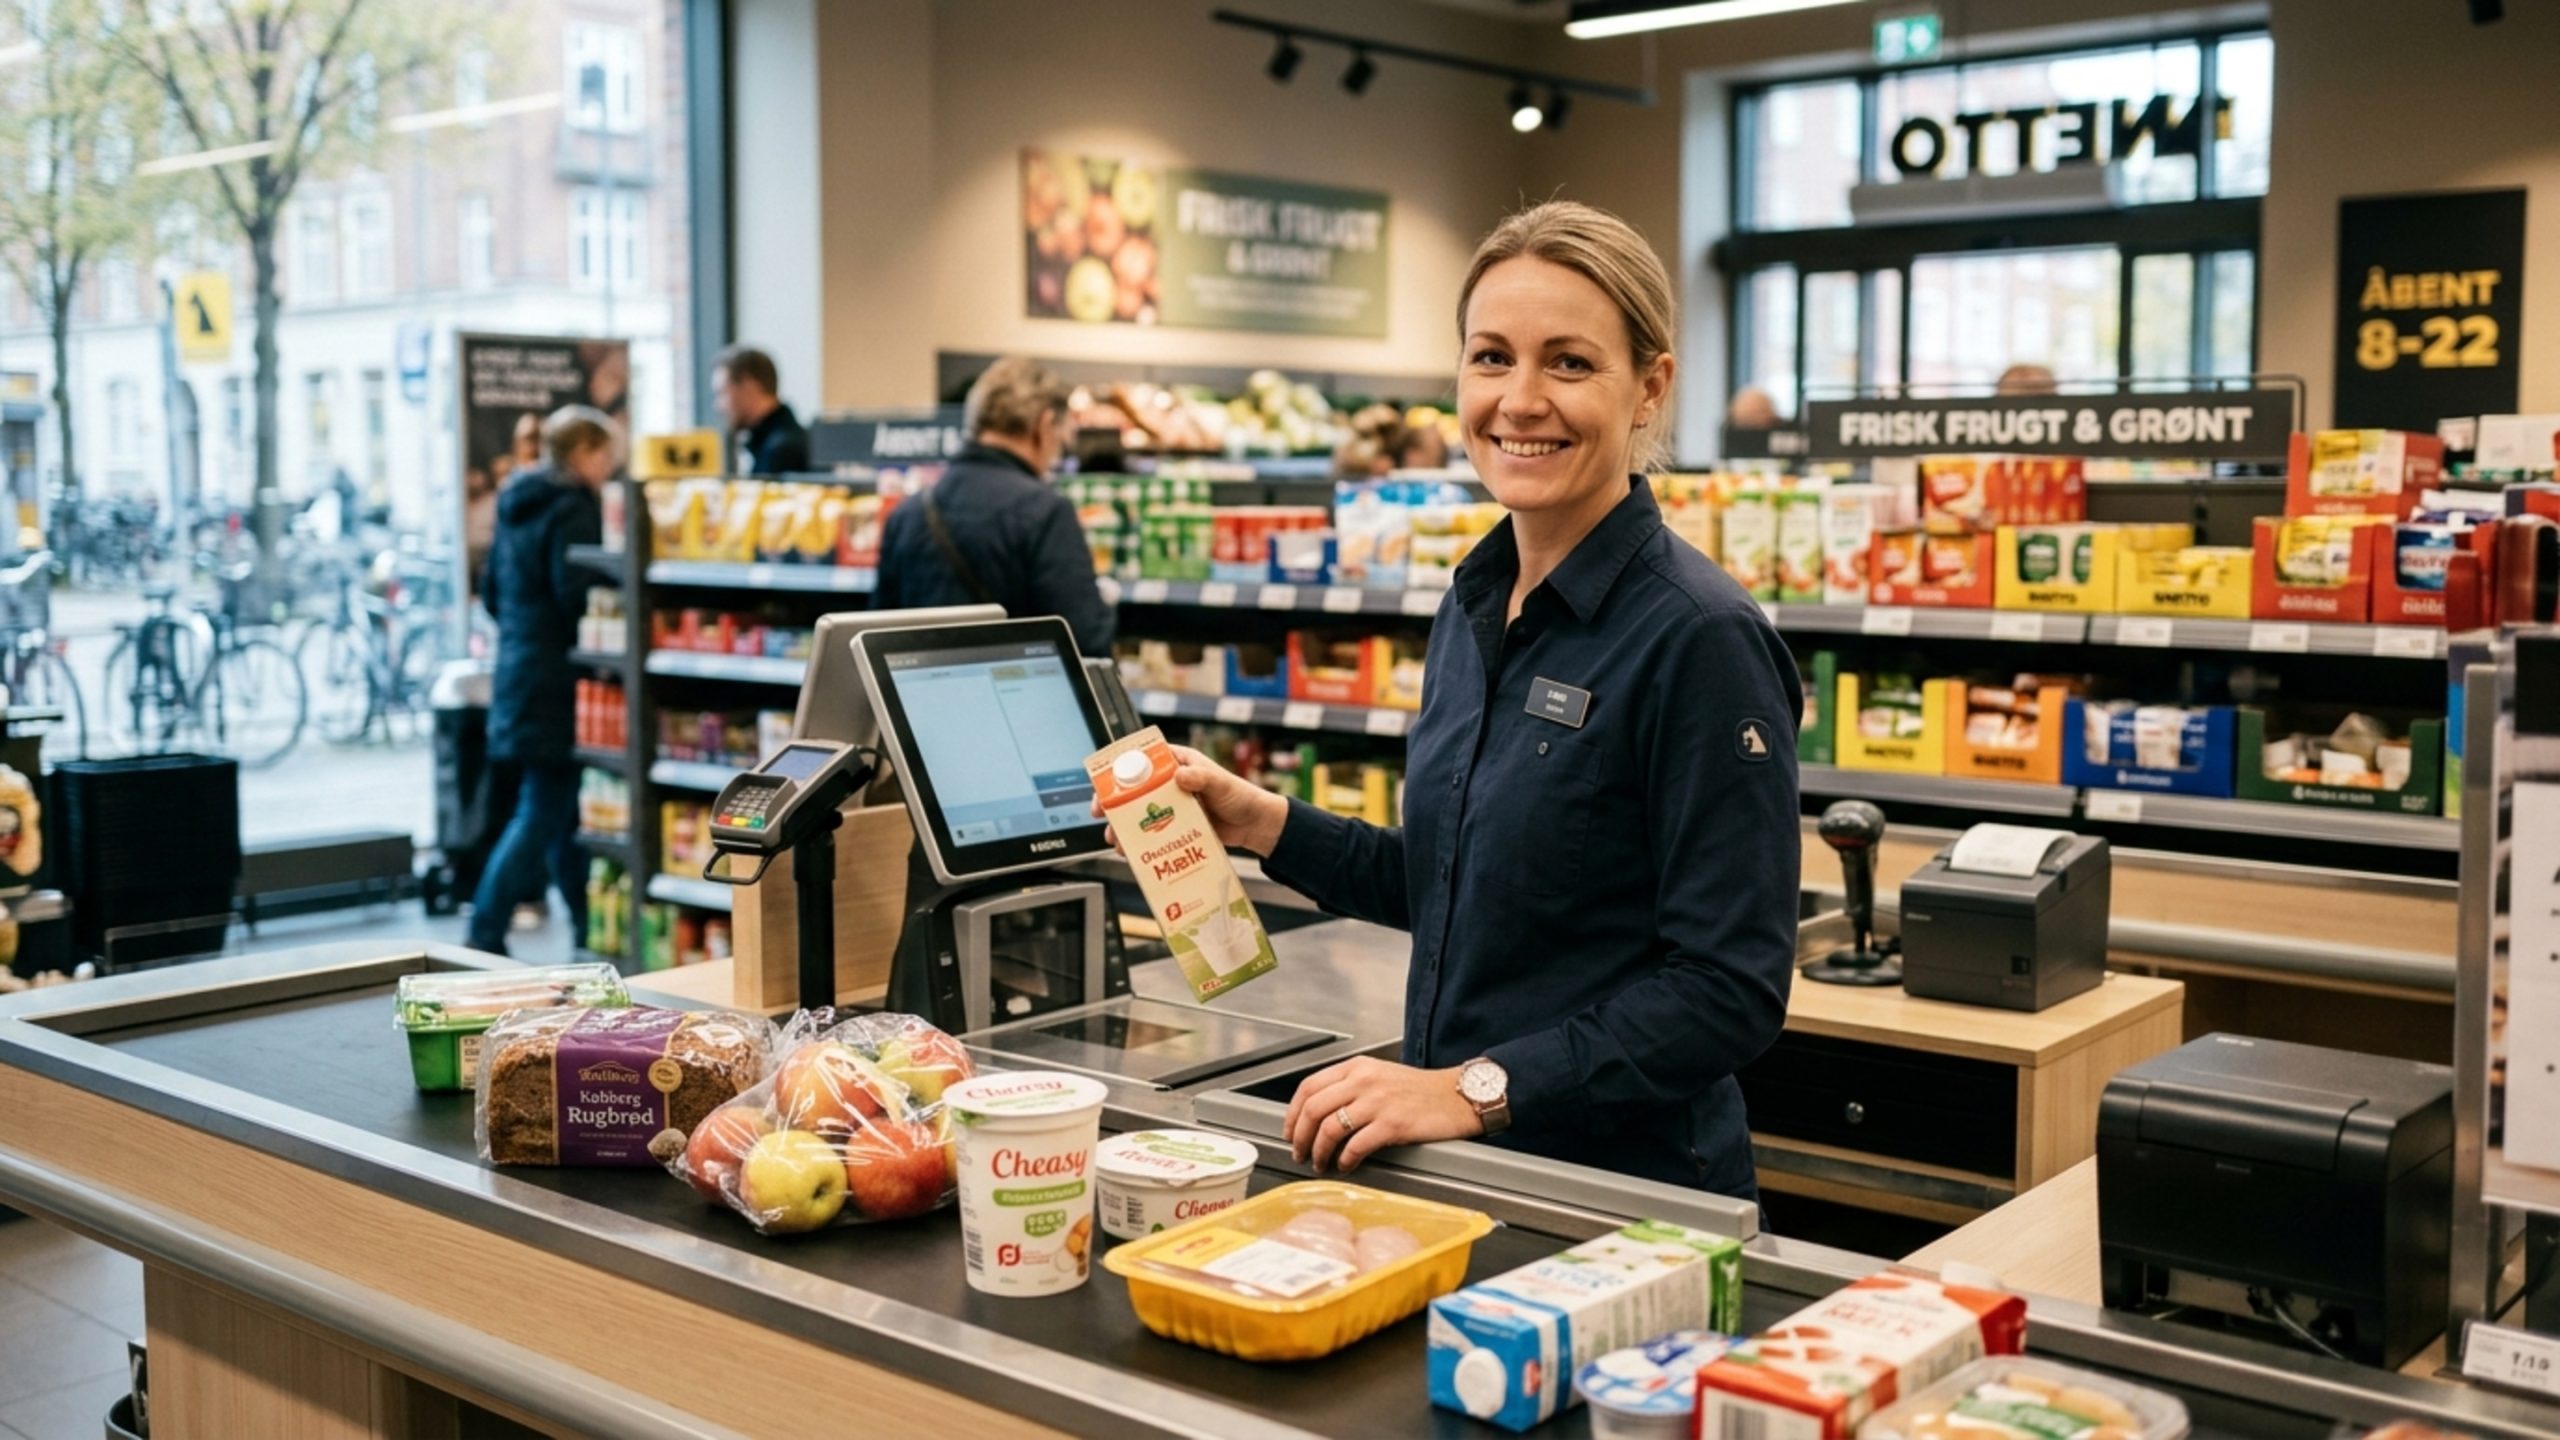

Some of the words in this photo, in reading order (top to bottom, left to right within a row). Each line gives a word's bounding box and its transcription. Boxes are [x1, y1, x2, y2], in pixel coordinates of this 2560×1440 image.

[2360, 265, 2501, 311] ÅBENT
[2356, 314, 2500, 370] 8-22
[1839, 411, 1939, 446] FRISK
[1945, 409, 2068, 445] FRUGT
[2073, 409, 2101, 443] &
[2109, 406, 2252, 443] GRØNT
[567, 1106, 655, 1128] Rugbrød
[992, 1149, 1088, 1178] Cheasy
